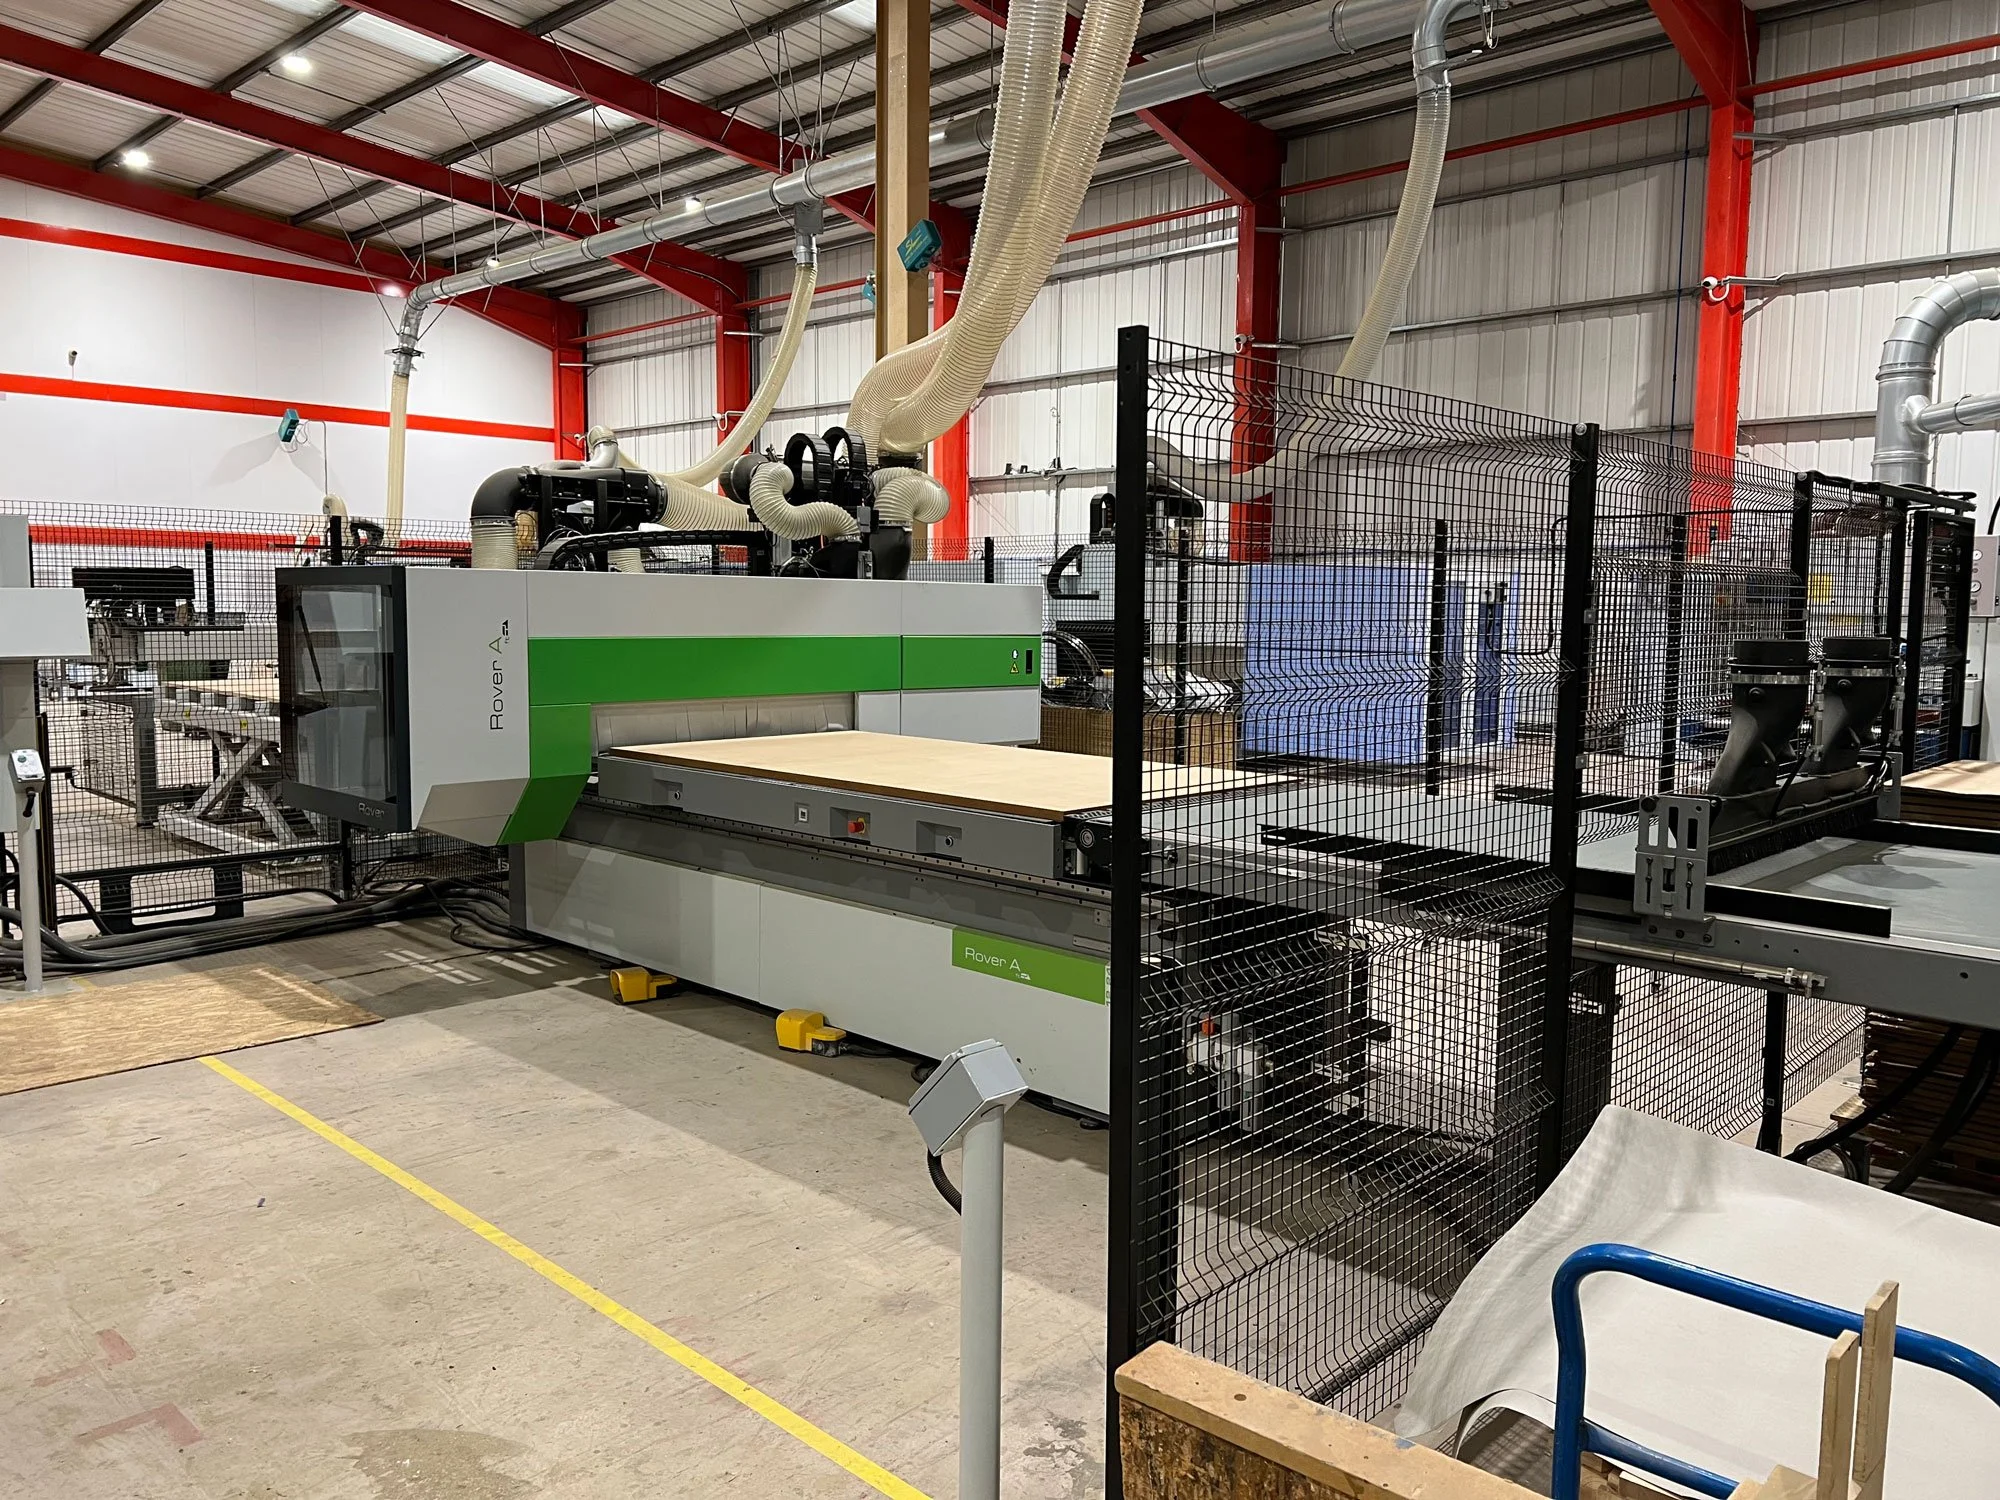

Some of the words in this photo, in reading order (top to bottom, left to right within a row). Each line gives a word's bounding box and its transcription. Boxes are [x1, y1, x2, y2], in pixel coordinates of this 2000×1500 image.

[488, 636, 502, 654] A
[490, 660, 504, 730] Rover
[965, 946, 1007, 967] Rover
[1009, 958, 1021, 972] A
